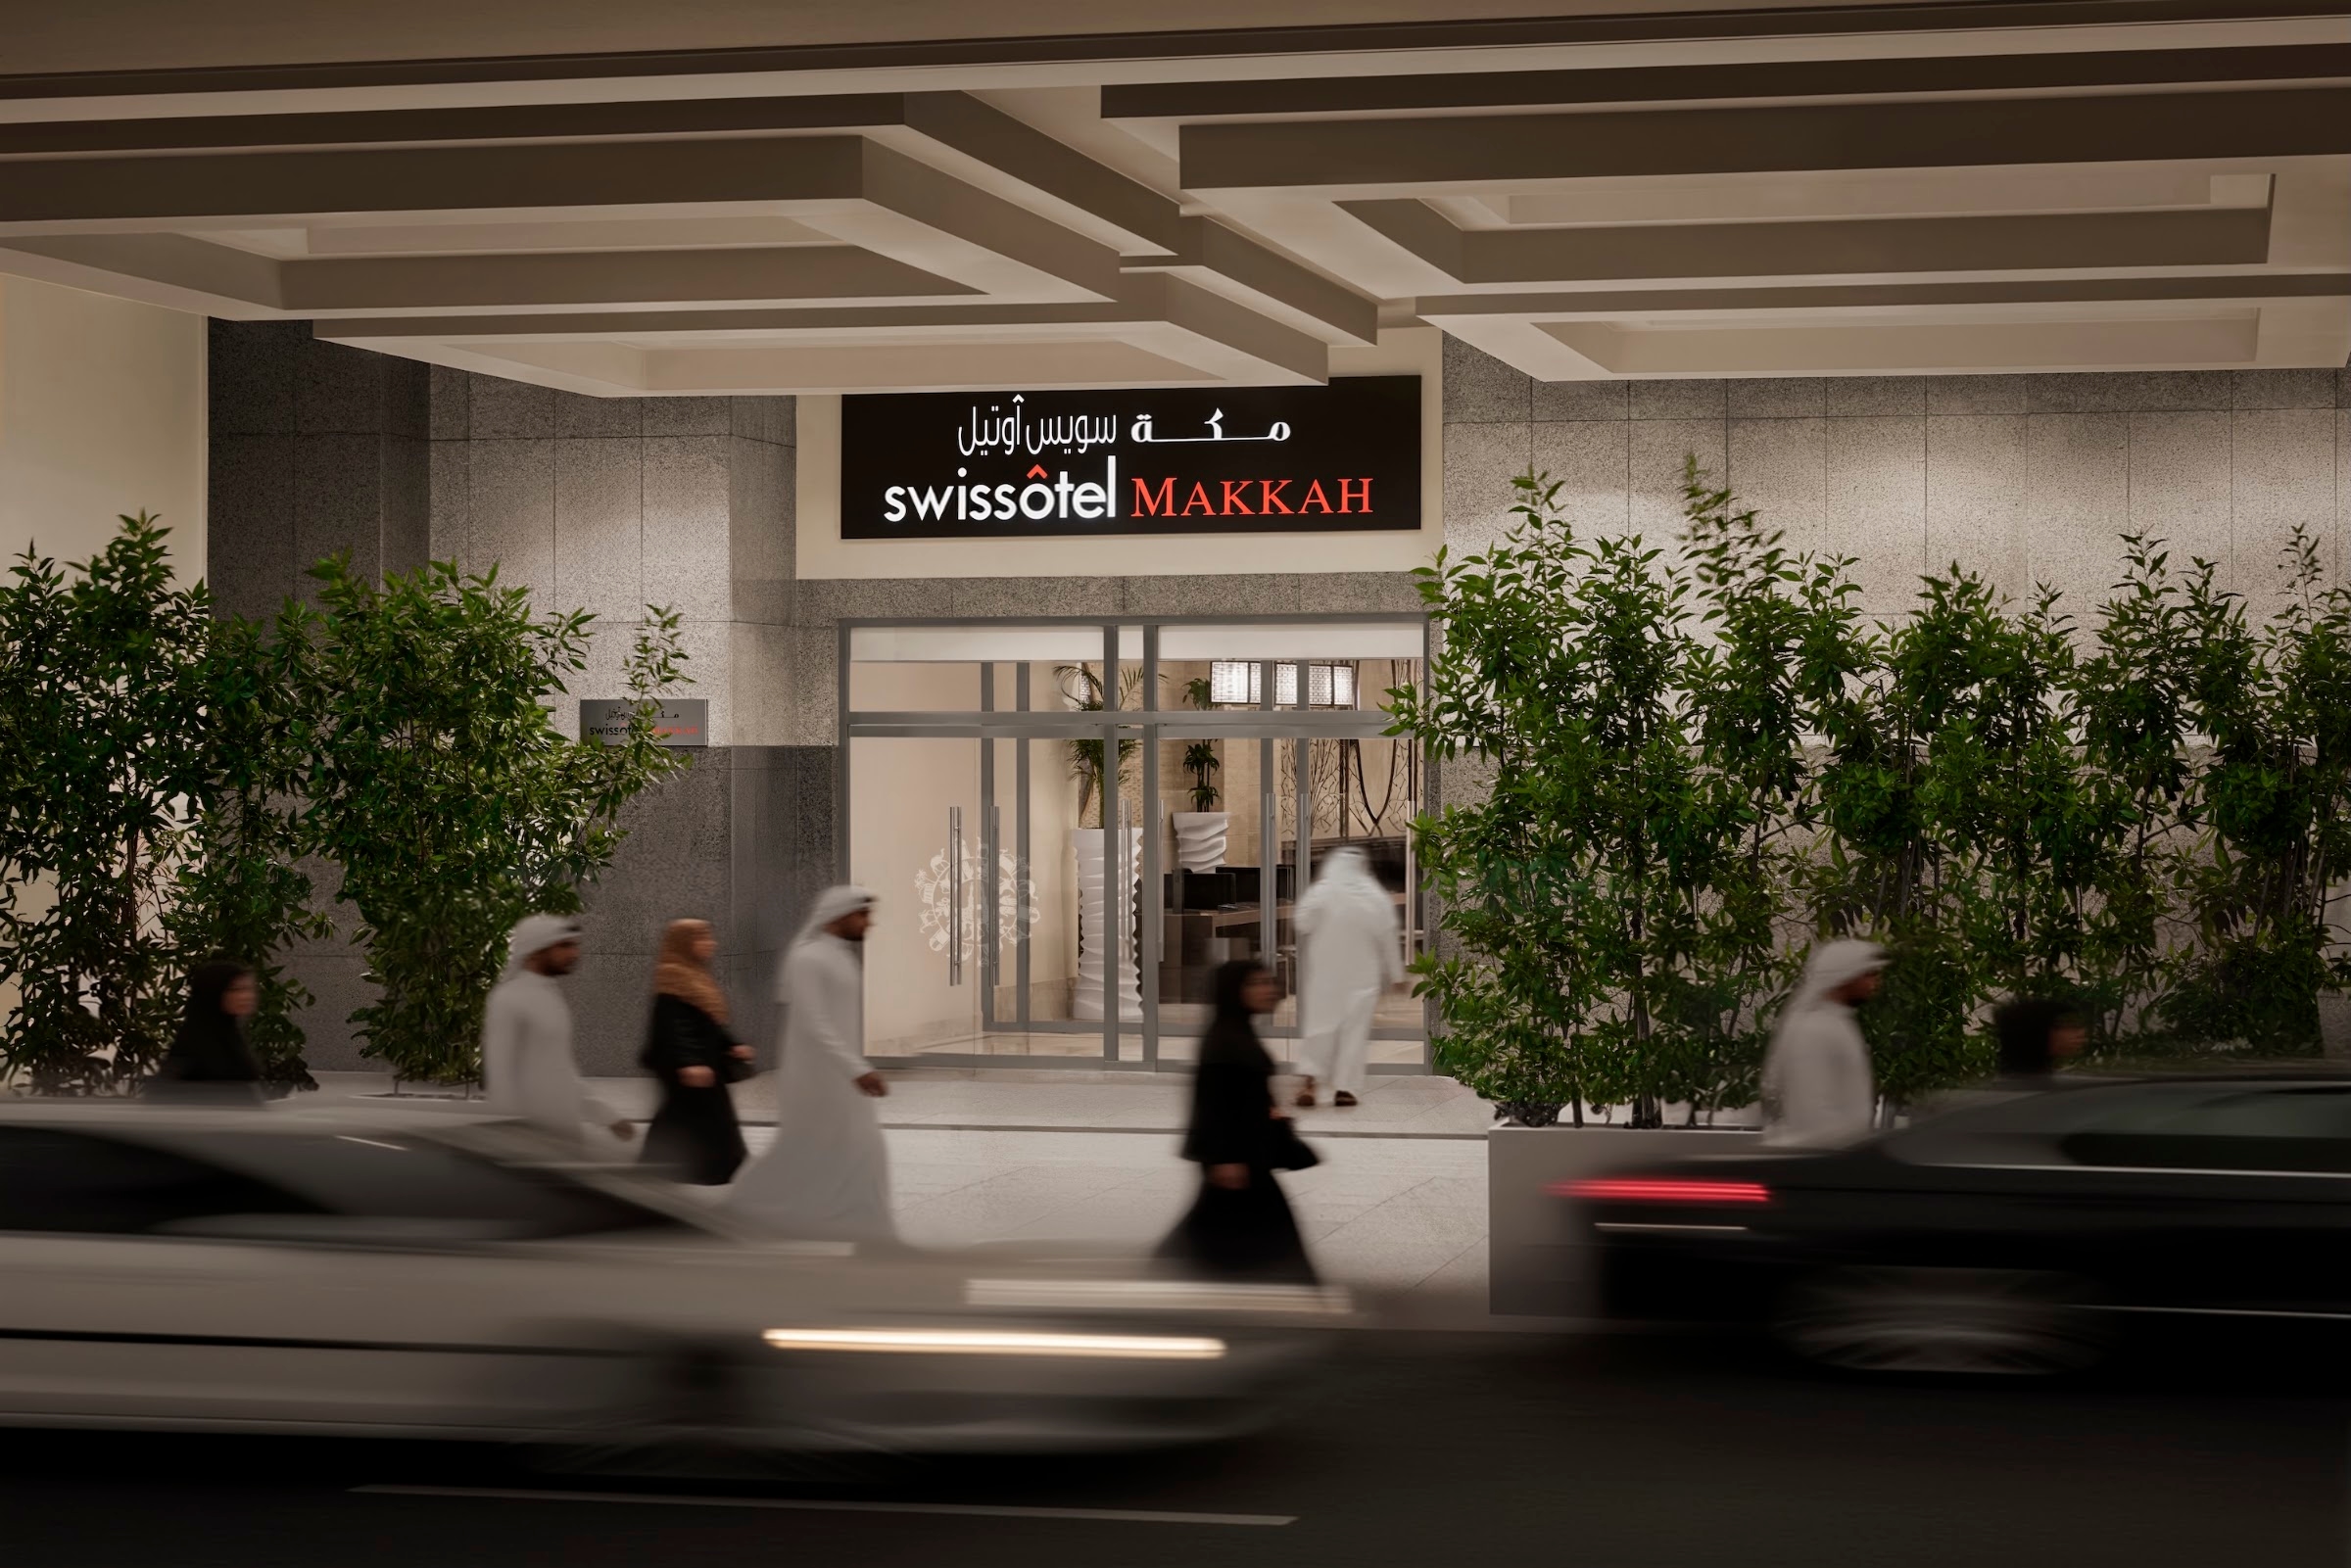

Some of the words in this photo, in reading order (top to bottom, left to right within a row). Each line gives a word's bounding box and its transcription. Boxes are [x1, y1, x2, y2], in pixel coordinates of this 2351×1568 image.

[1026, 404, 1117, 454] سويس
[1130, 407, 1291, 444] مكة
[883, 455, 1117, 522] swissôtel
[1130, 477, 1374, 518] MAKKAH
